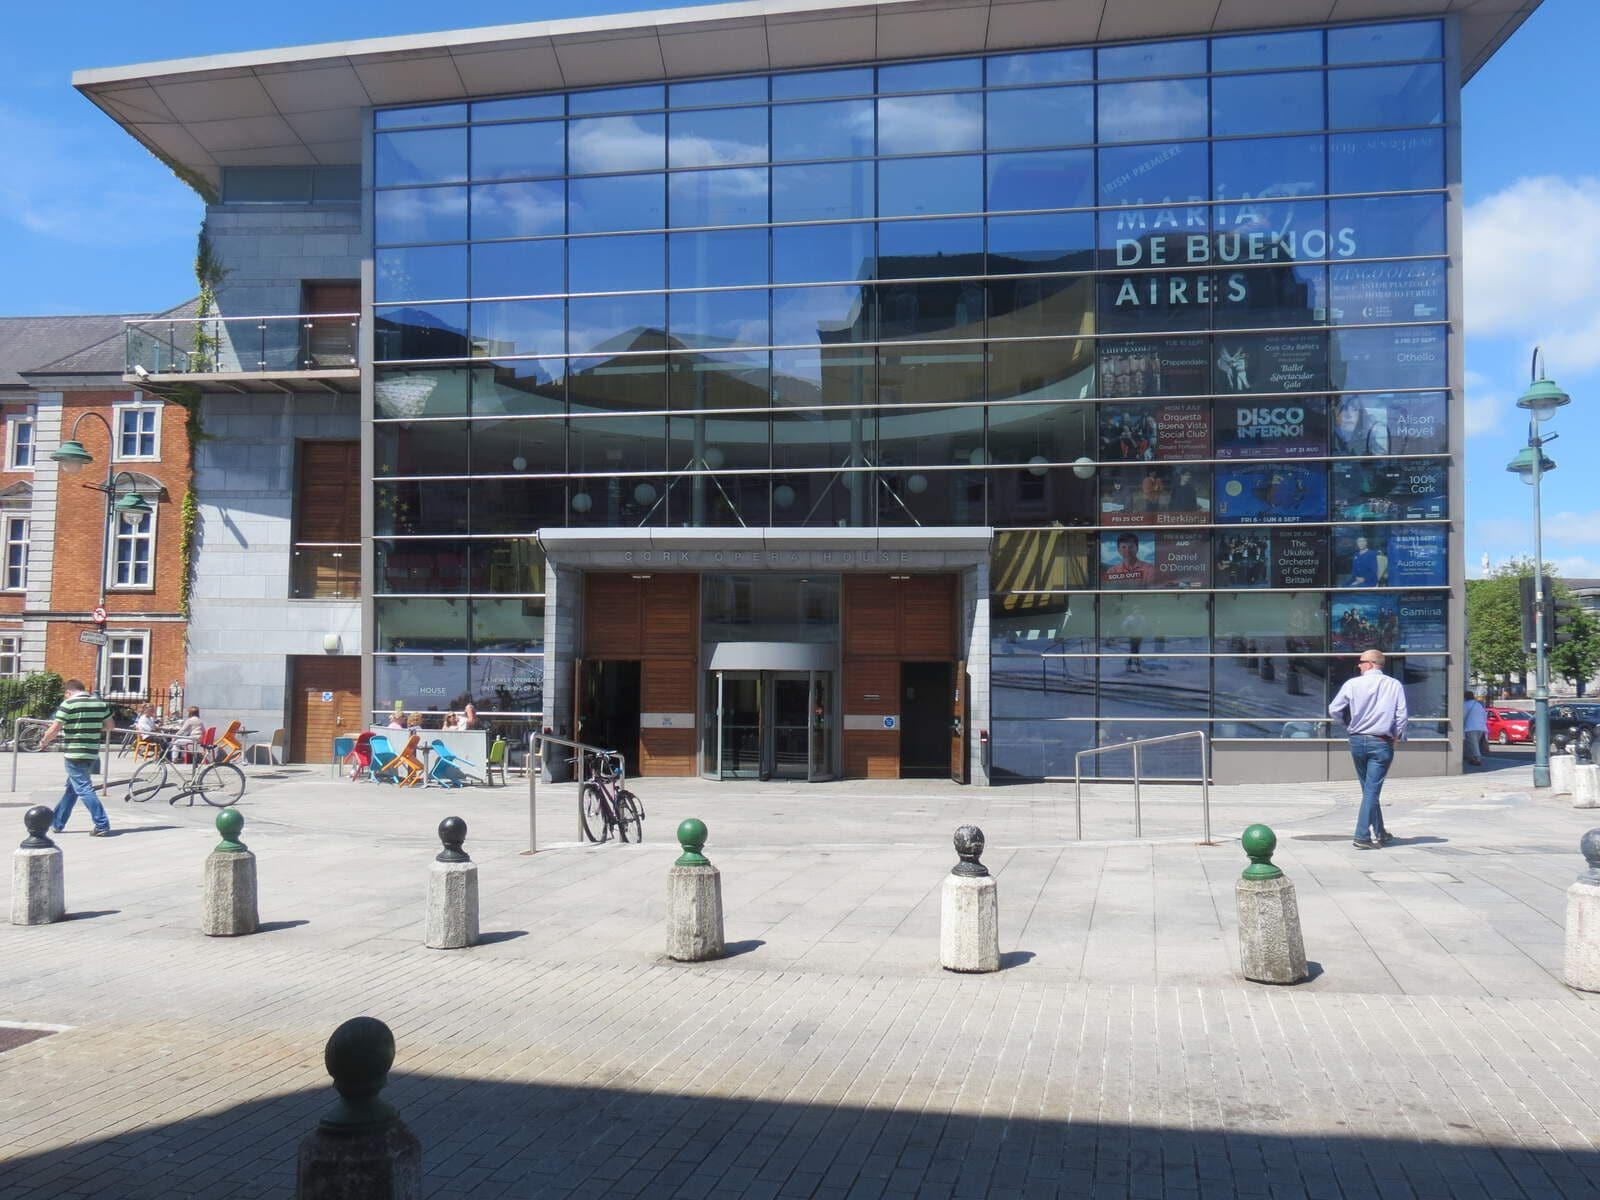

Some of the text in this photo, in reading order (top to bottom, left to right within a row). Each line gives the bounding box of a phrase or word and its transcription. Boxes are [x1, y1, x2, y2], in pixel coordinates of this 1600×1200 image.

[1116, 228, 1356, 266] DE BUENOS
[1115, 274, 1247, 306] AIRES
[1397, 352, 1436, 362] Othello
[1163, 414, 1202, 422] Orquesta
[1237, 407, 1304, 426] DISCO
[1397, 415, 1435, 424] Alison
[1158, 422, 1208, 430] Buena Vista
[1160, 430, 1185, 438] Social
[1411, 484, 1436, 494] Cork
[1290, 539, 1307, 547] The
[624, 552, 908, 561] CORK OPERA HOUSE
[1168, 553, 1197, 561] Daniel
[1283, 549, 1315, 557] Ukulele
[1279, 558, 1319, 566] Orchestra
[1160, 563, 1206, 572] O'Donnell
[1281, 567, 1316, 575] of Great
[1285, 576, 1313, 584] Britain
